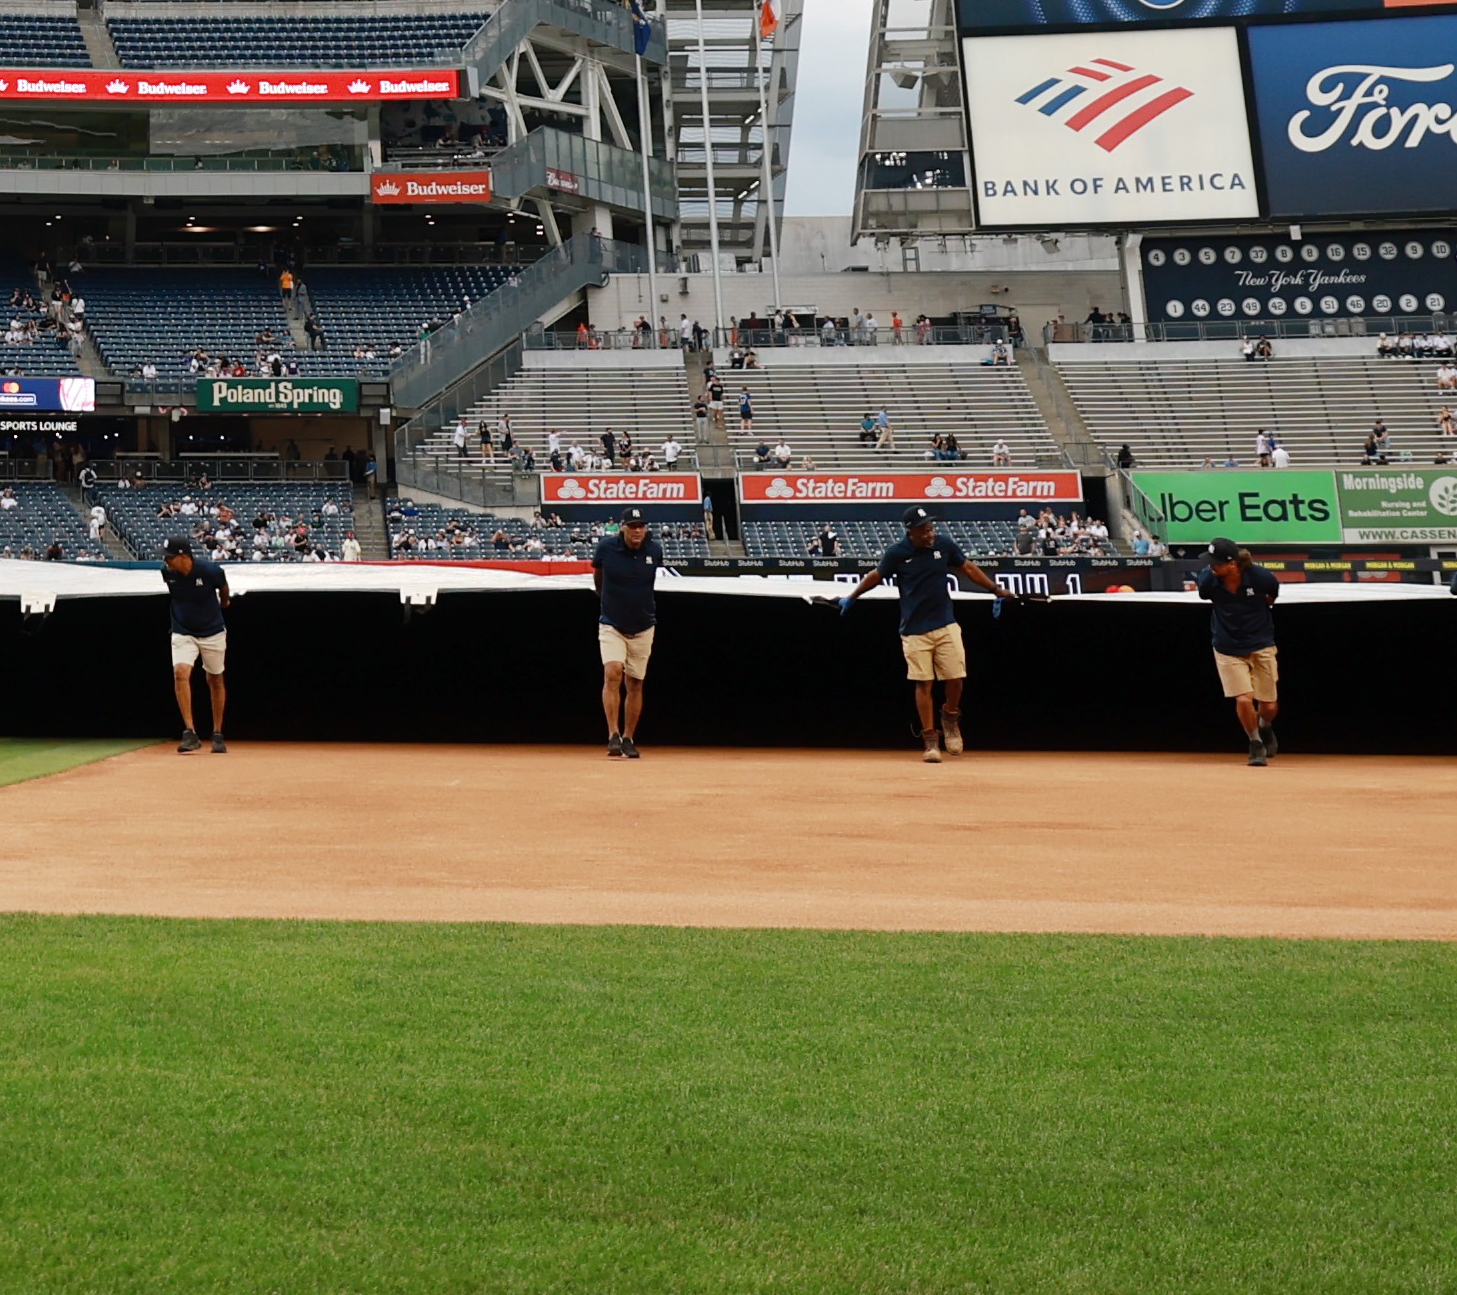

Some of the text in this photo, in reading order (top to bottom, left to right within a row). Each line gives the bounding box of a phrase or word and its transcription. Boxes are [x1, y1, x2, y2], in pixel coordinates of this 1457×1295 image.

[406, 181, 486, 196] Budweiser
[984, 172, 1246, 198] BANK OF AMERICA
[1153, 252, 1160, 262] 4
[1179, 252, 1185, 262] 3
[1204, 251, 1210, 261] 5
[1230, 250, 1236, 260] 7
[1252, 249, 1264, 259] 37
[1329, 247, 1342, 257] 16
[1356, 246, 1368, 256] 15
[1382, 245, 1394, 256] 32
[1411, 245, 1417, 255] 9
[1435, 244, 1447, 254] 10
[1235, 268, 1366, 292] New York Yankees
[1173, 304, 1177, 314] 1
[1194, 303, 1207, 313] 44
[1271, 301, 1283, 311] 42
[1300, 300, 1306, 310] 6
[1323, 299, 1336, 310] 51
[1349, 299, 1362, 309] 46
[1405, 297, 1412, 308] 2
[1429, 297, 1441, 307] 21
[212, 381, 342, 408] Poland Spring
[0, 421, 77, 432] SPORTS LOUNGE
[1342, 473, 1424, 493] Morningside
[1238, 492, 1330, 523] Eats
[1348, 510, 1399, 518] Rehabilitation
[1381, 501, 1409, 510] Nursing
